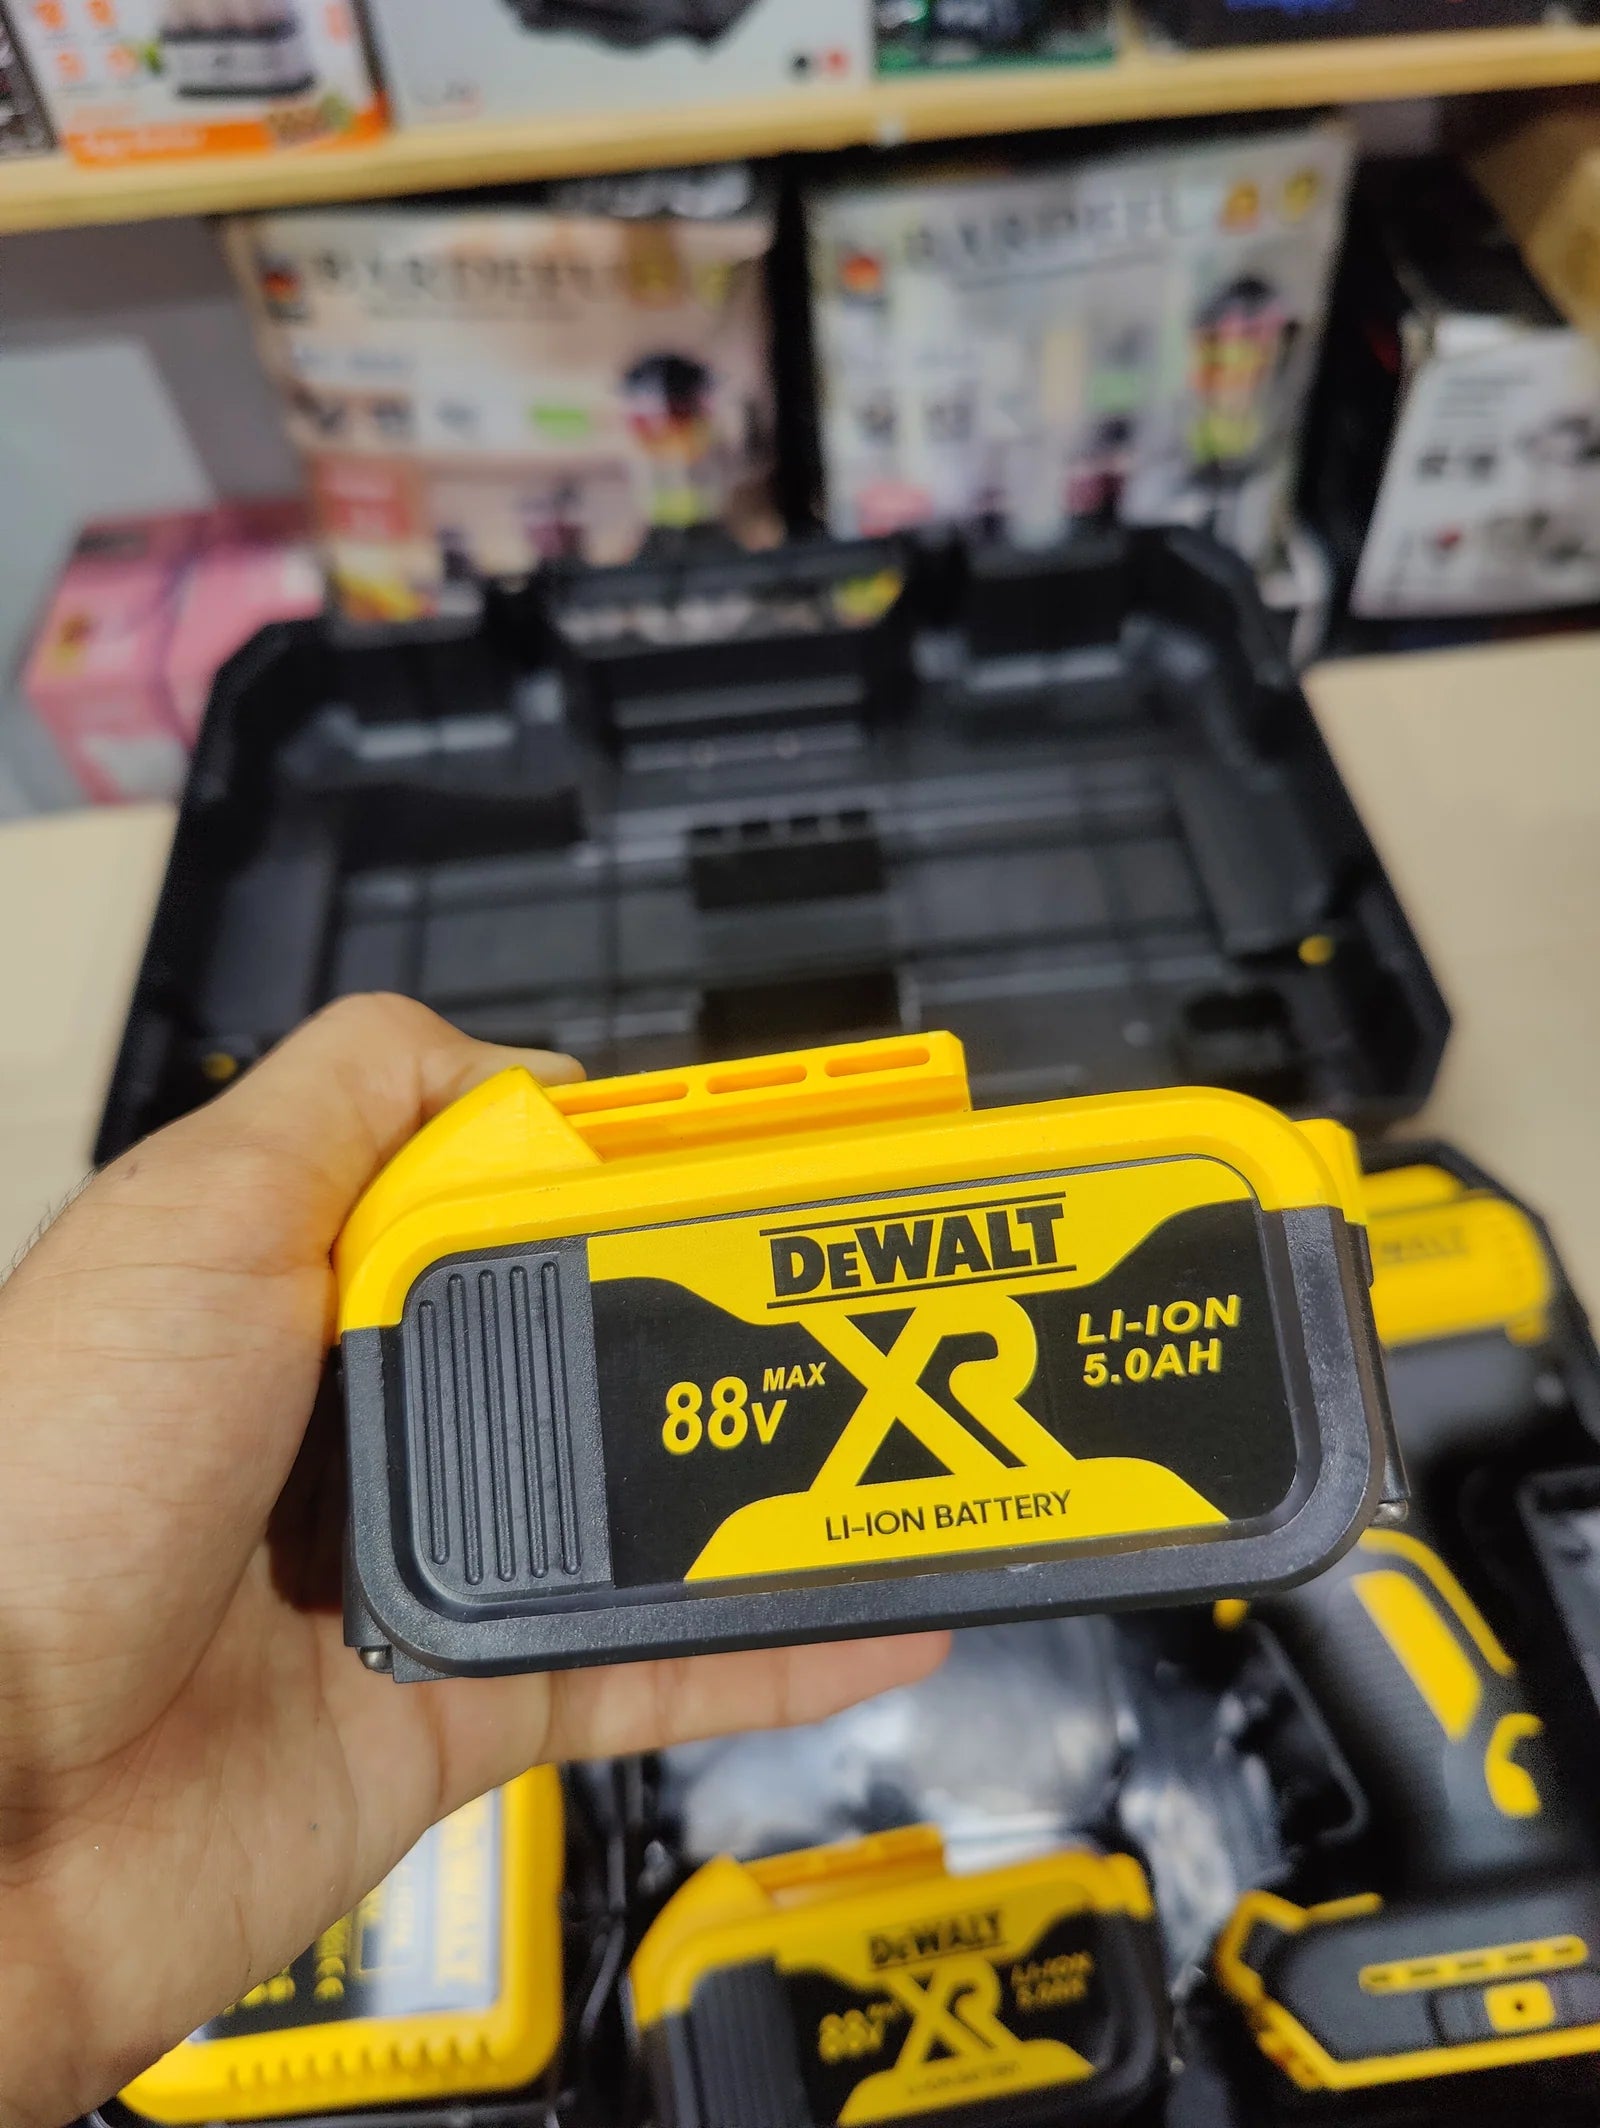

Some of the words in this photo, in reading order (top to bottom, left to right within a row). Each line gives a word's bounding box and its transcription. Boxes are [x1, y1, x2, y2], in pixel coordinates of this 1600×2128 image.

[1077, 1294, 1240, 1345] LI-ION
[762, 1361, 826, 1392] MAX
[1082, 1339, 1222, 1387] 5.0AH
[800, 1295, 1078, 1487] XR
[825, 1507, 924, 1541] LI-ION
[935, 1489, 1071, 1527] BATTERY
